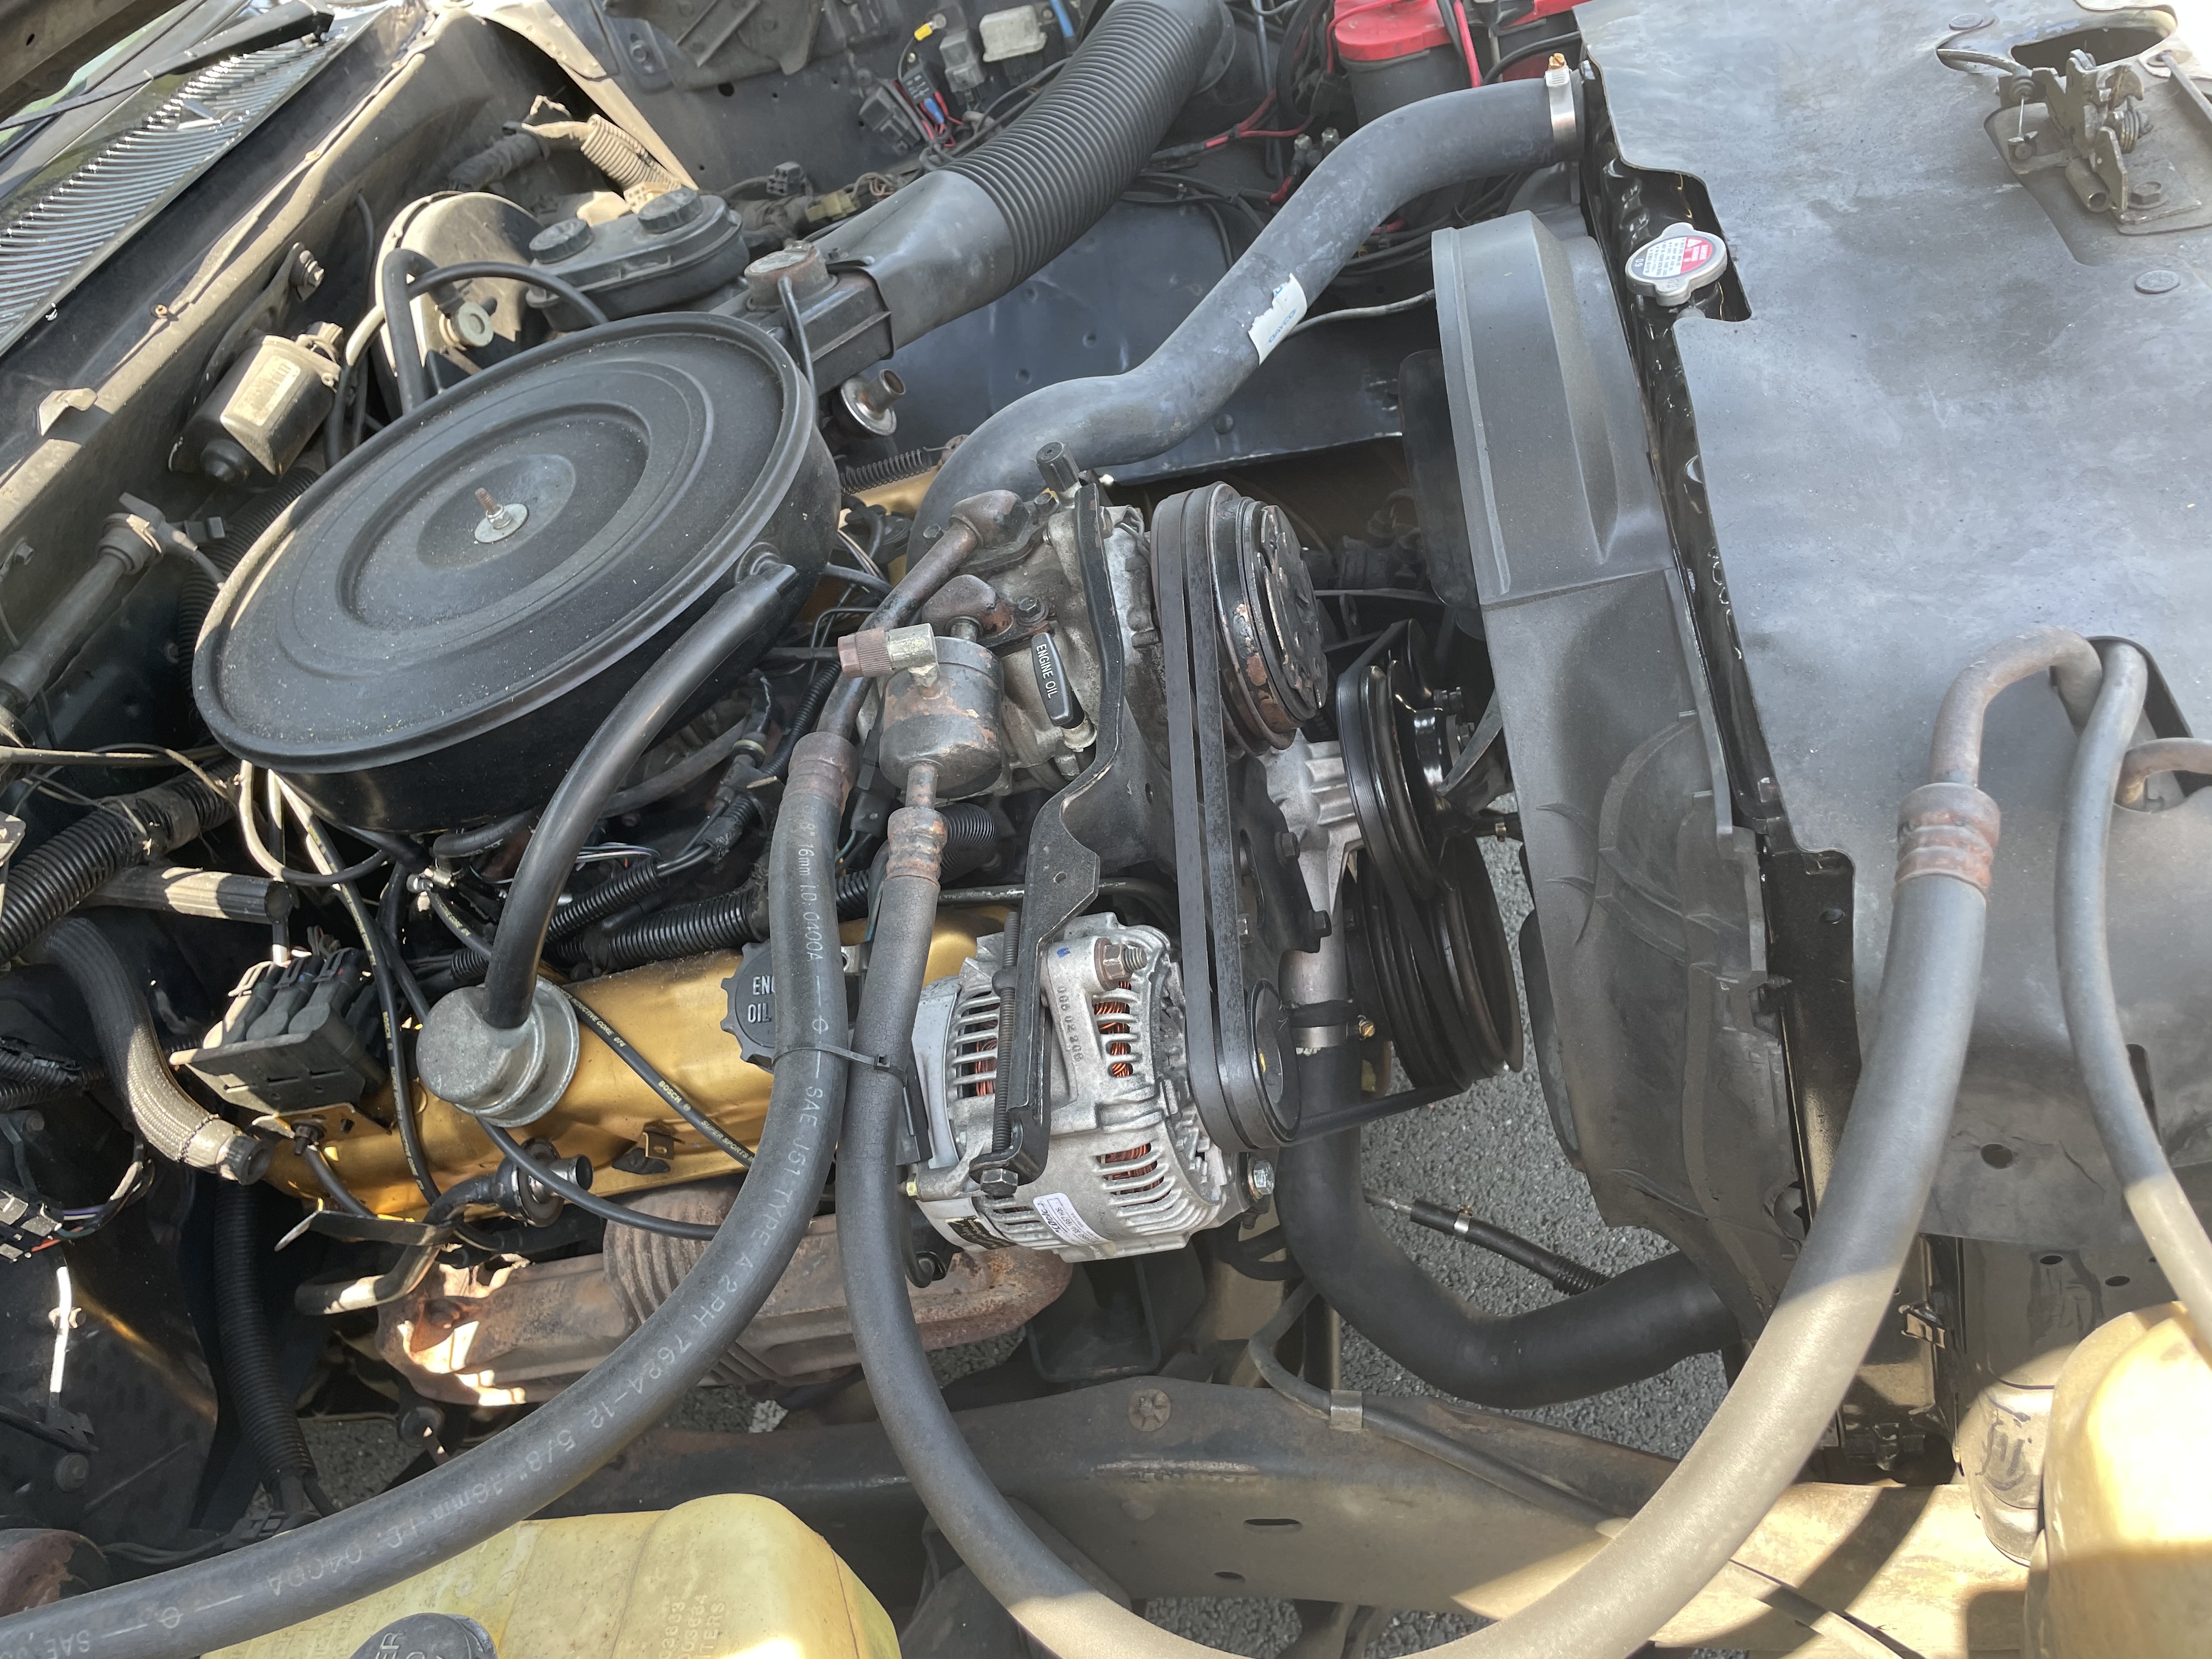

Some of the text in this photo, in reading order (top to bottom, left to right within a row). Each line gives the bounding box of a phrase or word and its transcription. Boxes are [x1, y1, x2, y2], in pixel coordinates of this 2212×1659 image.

[1268, 309, 1296, 343] DAYCO
[1036, 644, 1058, 699] ENGINE OIL
[798, 844, 815, 876] 16mm
[571, 997, 600, 1022] INDUCTIVE
[596, 1020, 614, 1036] CORE
[747, 1002, 772, 1024] OIL
[658, 1080, 682, 1103] BOSCH
[701, 1120, 724, 1139] SUPER
[722, 1137, 749, 1158] SPORTS
[799, 1086, 823, 1127] SAE
[750, 1189, 794, 1246] TYPE
